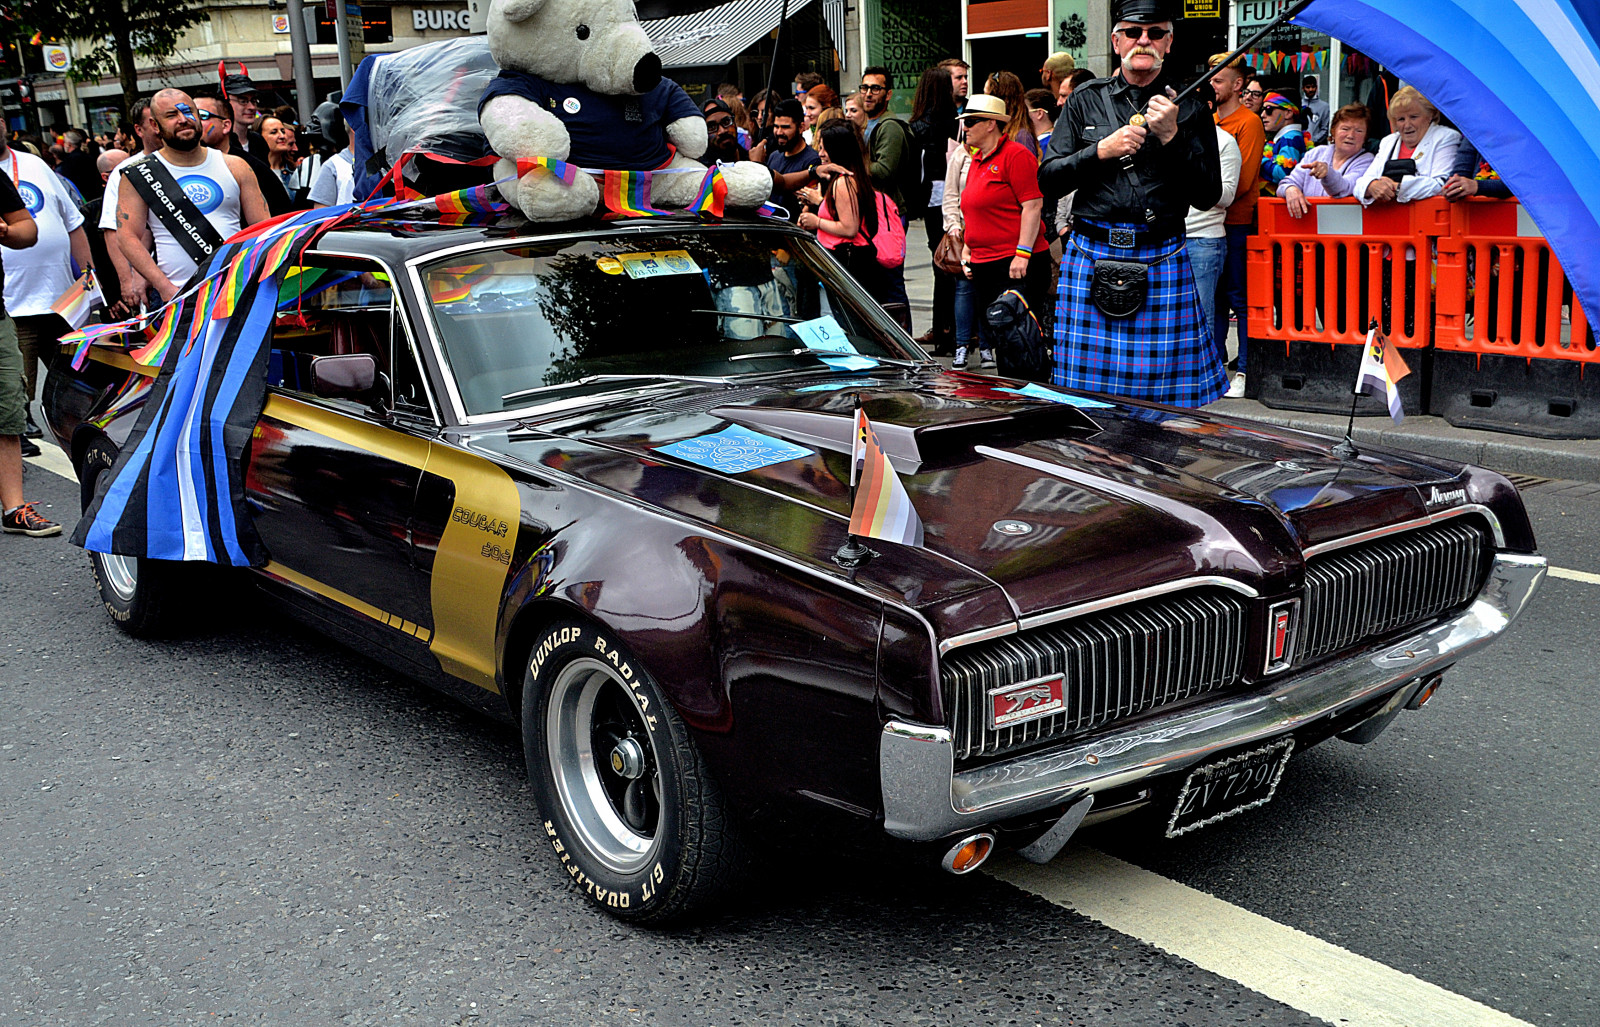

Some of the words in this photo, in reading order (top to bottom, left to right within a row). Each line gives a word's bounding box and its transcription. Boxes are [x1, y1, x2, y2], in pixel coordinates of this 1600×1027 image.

[452, 506, 509, 538] COUGAR
[530, 627, 581, 681] DUNLOP
[594, 636, 658, 732] RADIAL
[1180, 779, 1221, 816] ZV
[1223, 760, 1279, 800] 7291
[544, 820, 630, 908] QUALIFIER
[641, 861, 664, 902] G/T
